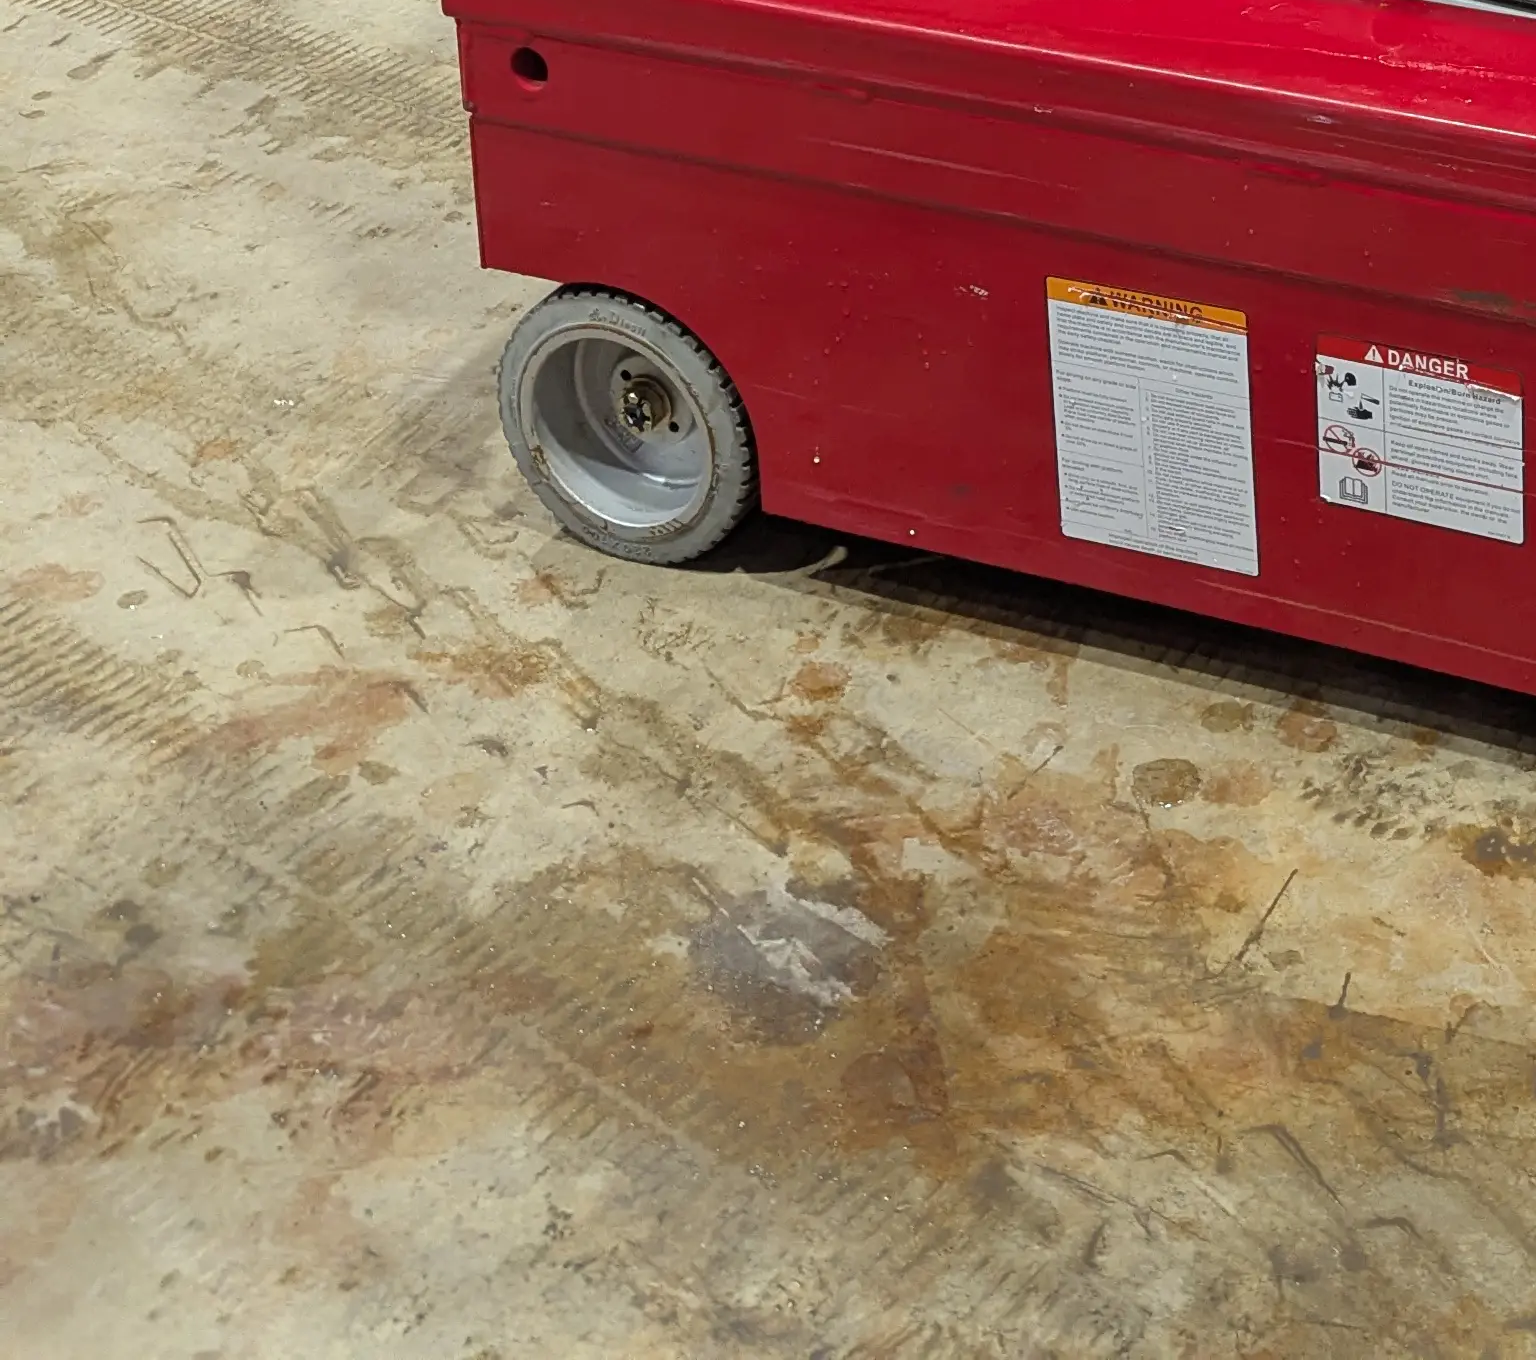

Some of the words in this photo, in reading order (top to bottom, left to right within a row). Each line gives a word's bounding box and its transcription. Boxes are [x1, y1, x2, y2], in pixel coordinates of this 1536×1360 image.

[1110, 290, 1204, 324] WARNING
[1387, 349, 1470, 380] DANGER
[1472, 392, 1501, 405] Hazard
[1391, 480, 1402, 488] DO
[1404, 483, 1418, 492] NOT
[1419, 486, 1454, 499] OPERATE
